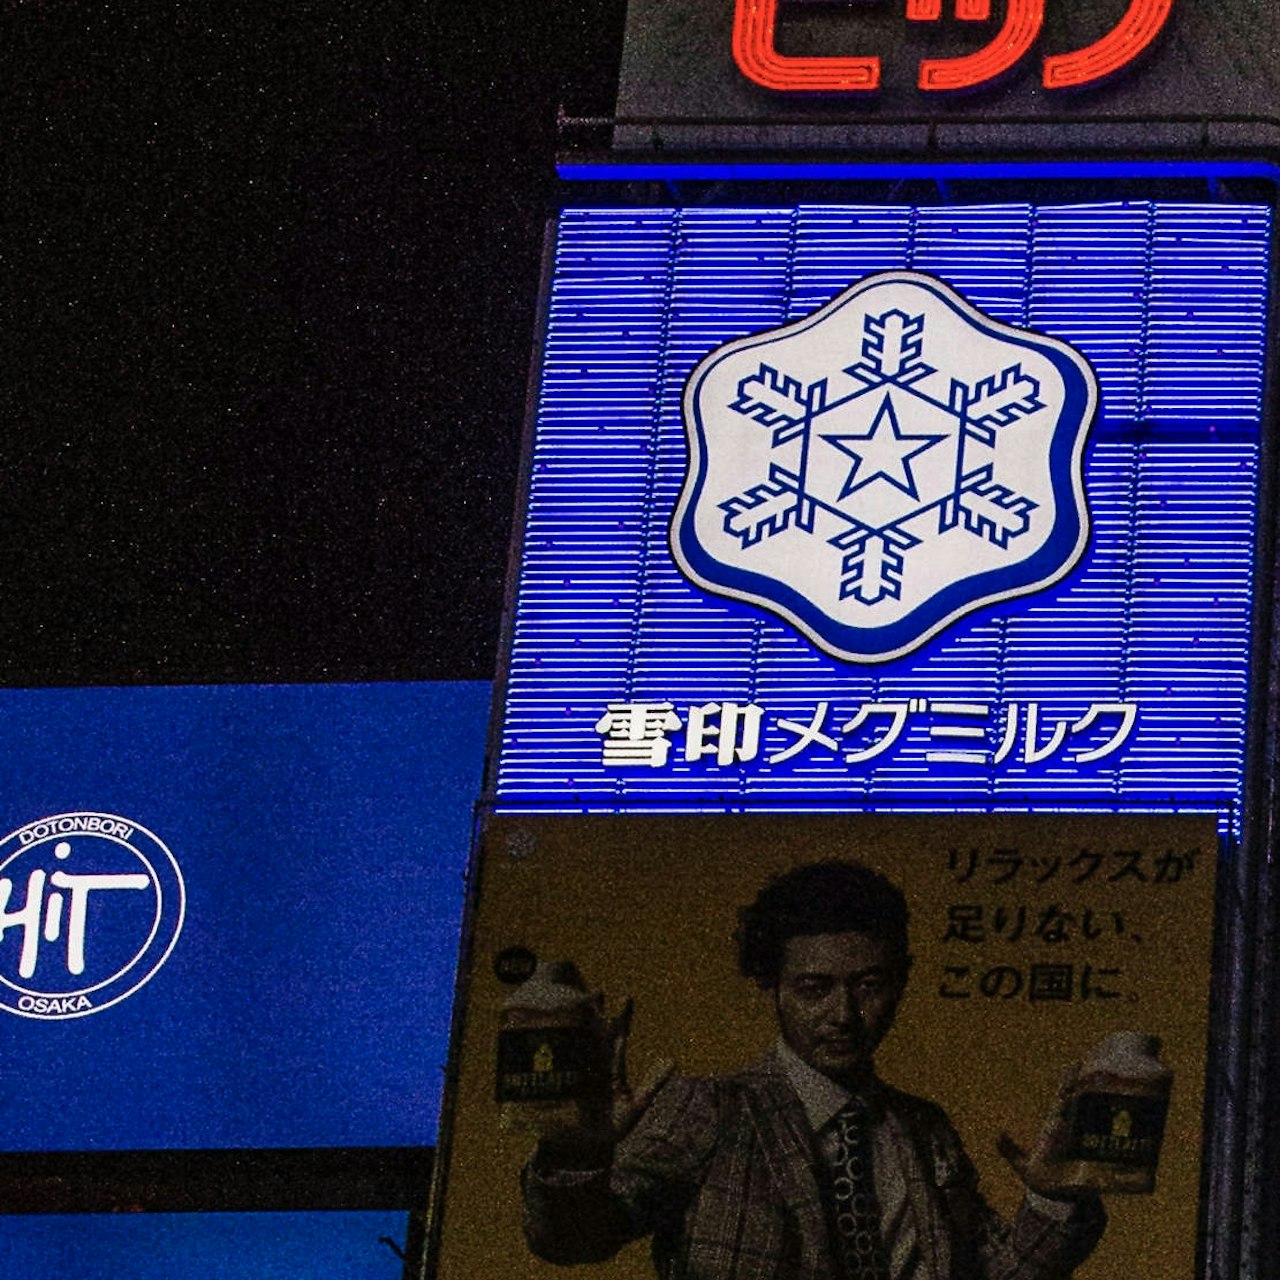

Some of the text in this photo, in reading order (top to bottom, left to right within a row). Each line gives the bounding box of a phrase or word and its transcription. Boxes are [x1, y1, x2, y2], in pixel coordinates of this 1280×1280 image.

[595, 698, 1138, 768] 雪印メグミルク
[18, 817, 134, 846] DOTONBORI
[946, 847, 1200, 885] リラックスが
[942, 903, 1142, 943] 足りない、
[938, 961, 1140, 1002] この国に。
[17, 995, 93, 1014] OSAKA
